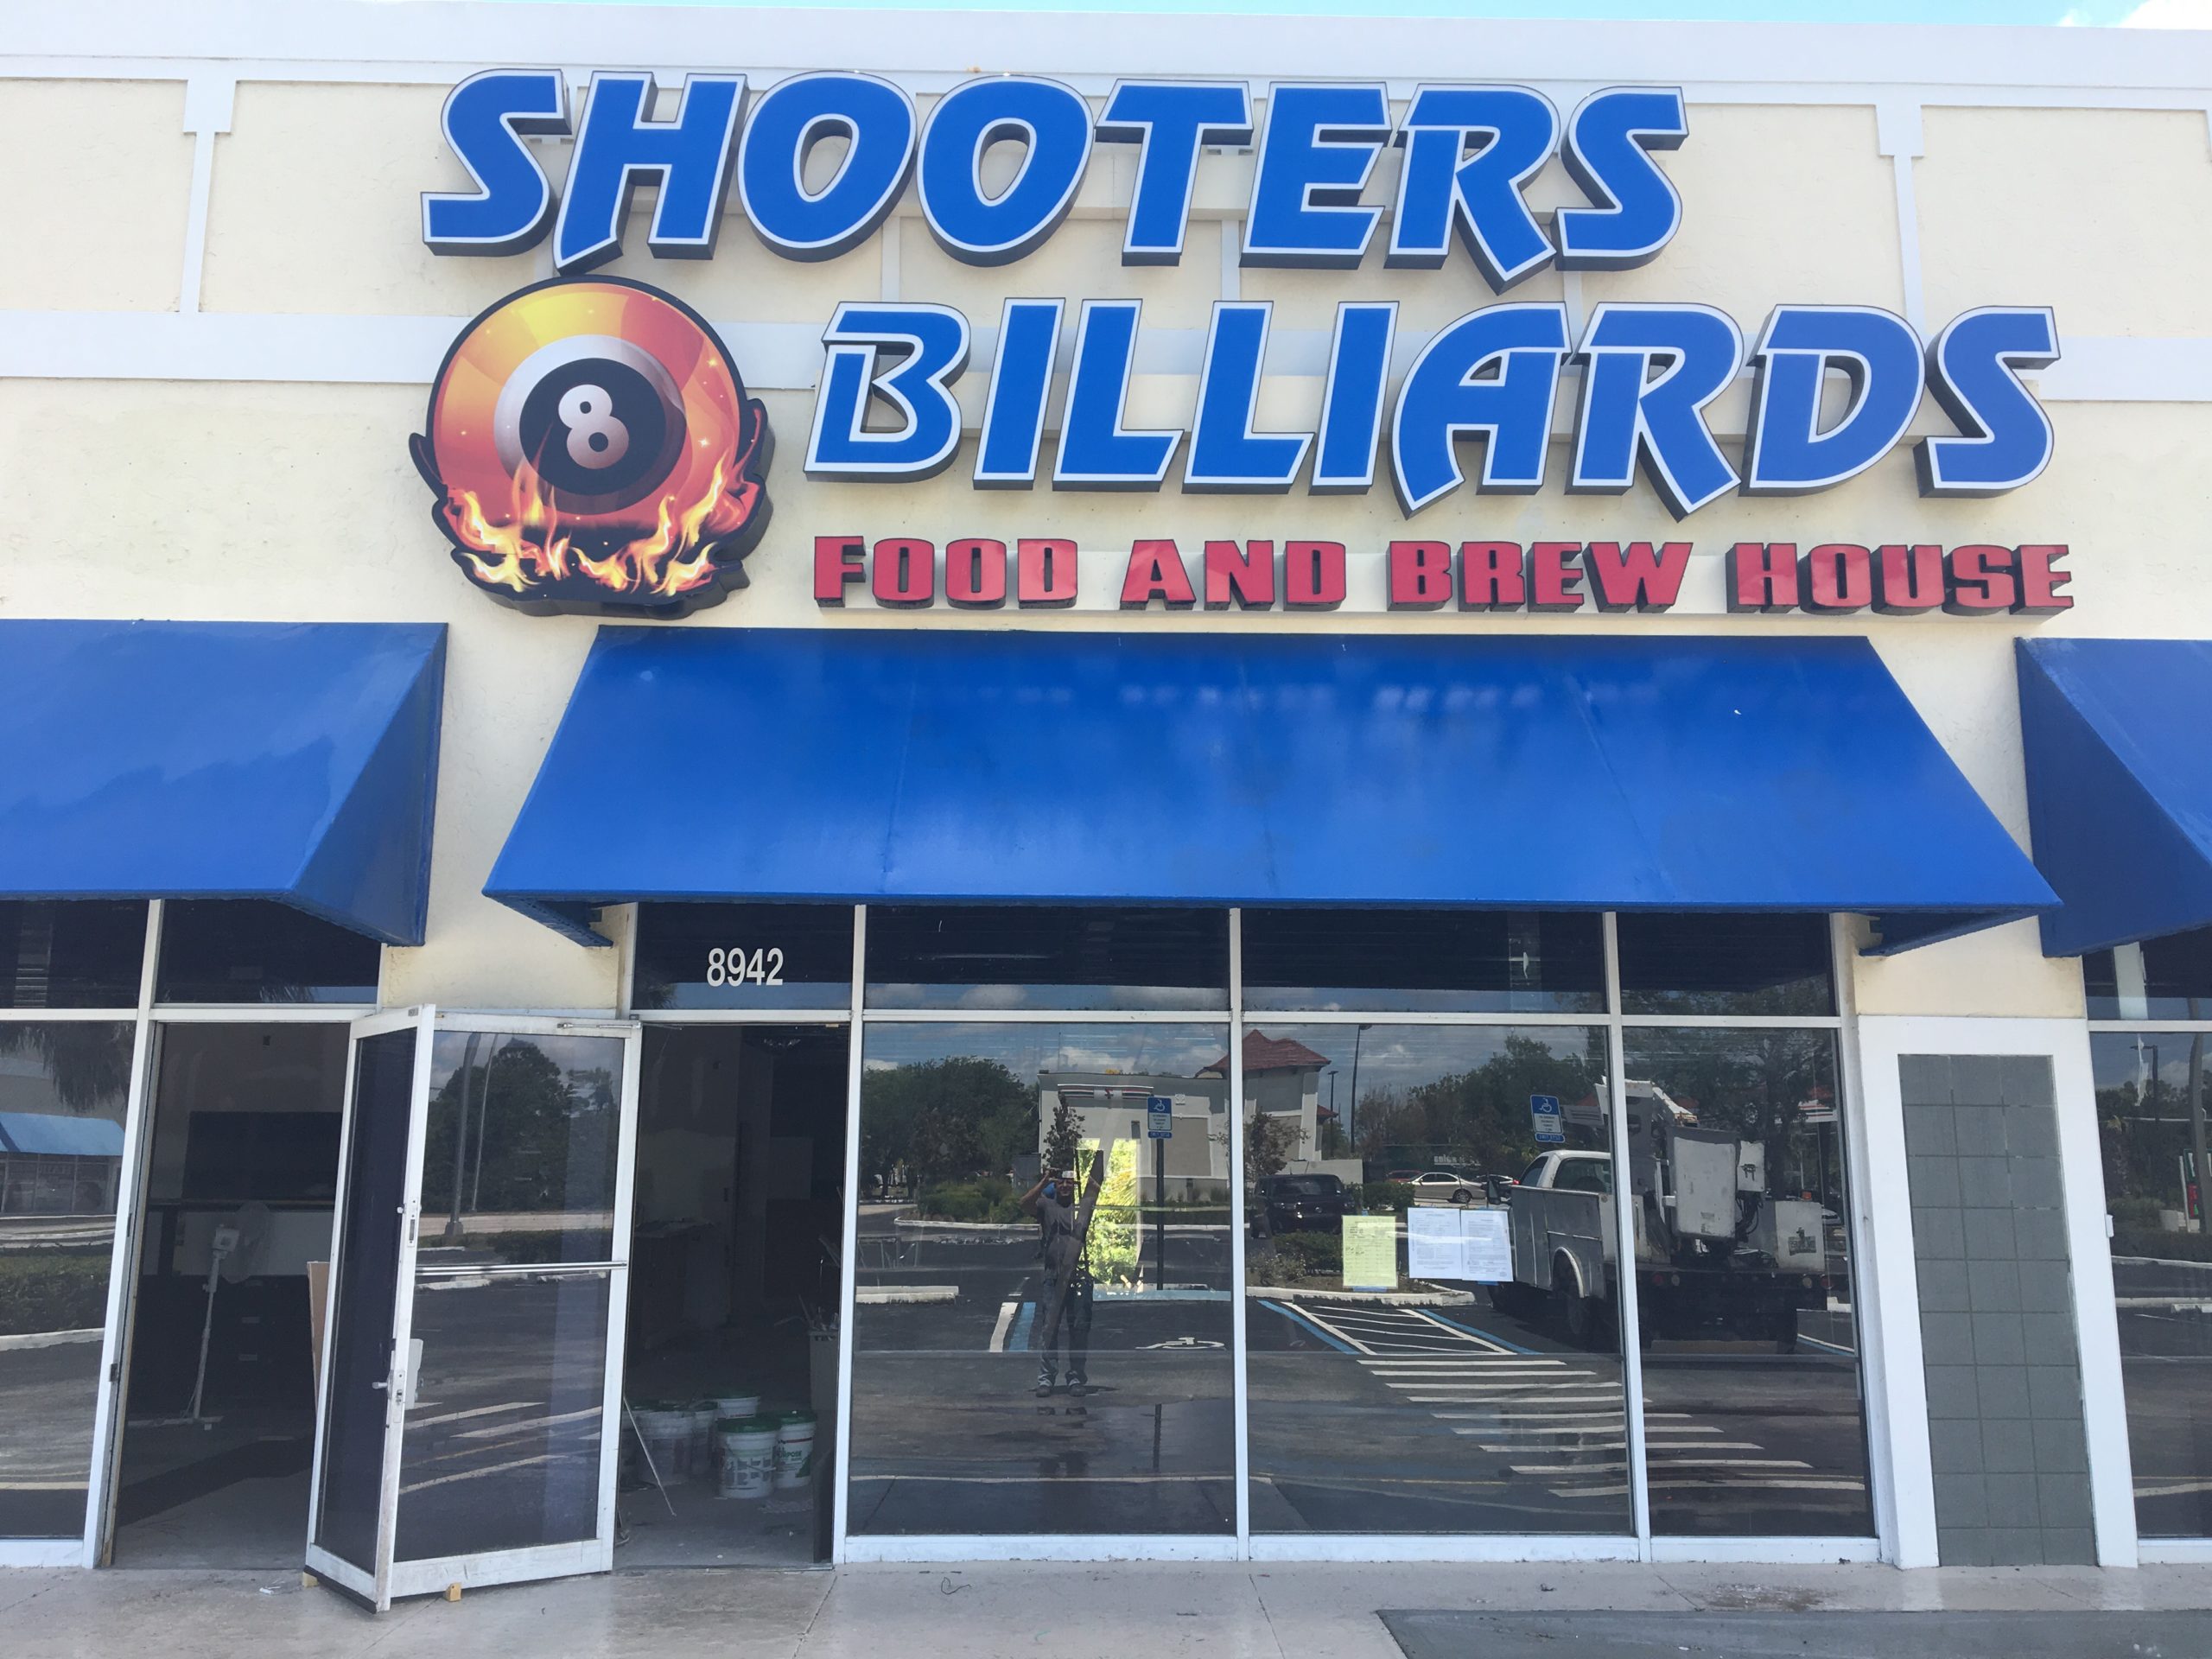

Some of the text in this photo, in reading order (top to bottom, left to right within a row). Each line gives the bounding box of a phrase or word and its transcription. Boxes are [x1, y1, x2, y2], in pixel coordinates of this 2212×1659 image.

[421, 68, 1689, 291] SHOOTERS
[558, 384, 629, 470] 8
[804, 297, 2062, 522] BILLIARDS
[814, 536, 2074, 616] FOOD AND BREW HOUSE
[707, 947, 784, 987] 8942
